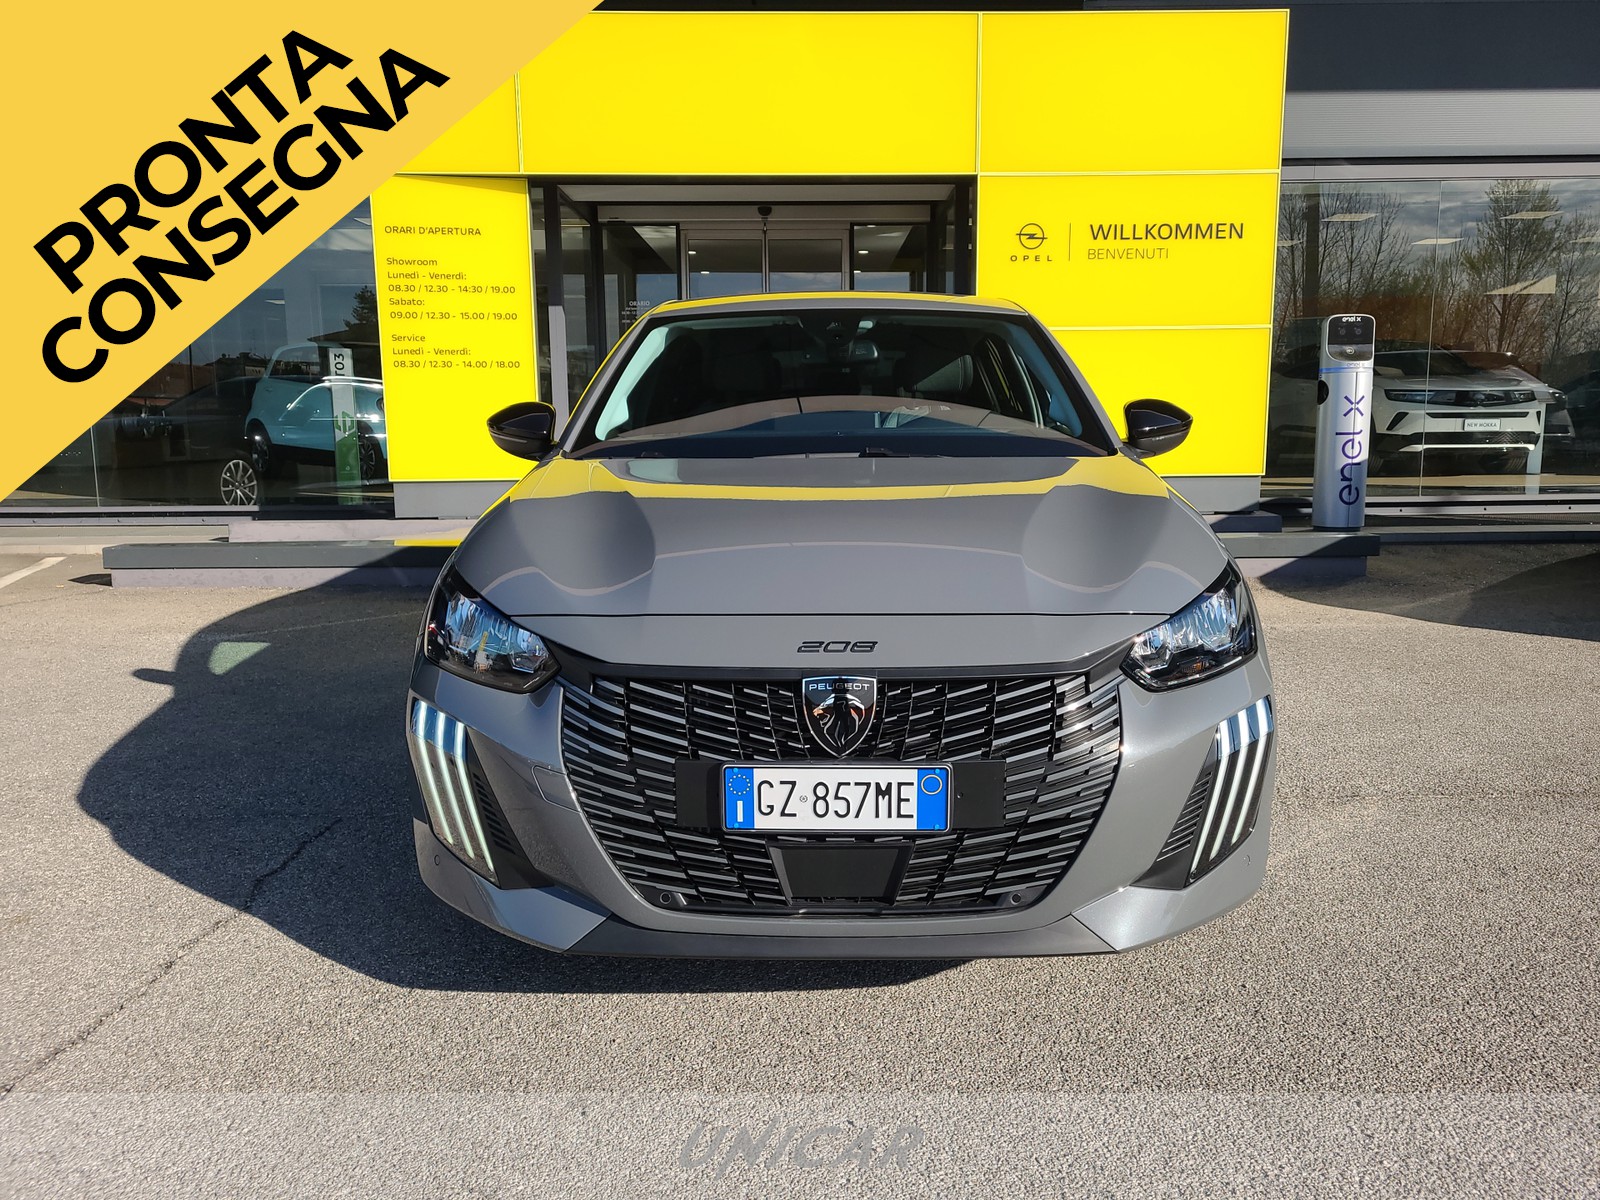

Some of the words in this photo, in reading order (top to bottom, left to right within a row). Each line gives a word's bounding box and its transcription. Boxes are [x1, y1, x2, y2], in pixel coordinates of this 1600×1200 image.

[384, 225, 416, 234] ORARI
[418, 226, 482, 236] D'APERTURA
[1089, 222, 1244, 241] WILLKOMMEN
[1010, 254, 1053, 262] OPEL
[1087, 247, 1169, 260] BENVENUTI
[386, 257, 438, 266] Showroom
[387, 271, 419, 279] Lunedì
[428, 272, 467, 280] Venerdì:
[388, 284, 416, 292] 08.30
[424, 284, 449, 292] 12.30
[491, 285, 516, 293] 19.00
[389, 297, 425, 306] Sabato:
[390, 311, 418, 320] 09.00
[426, 311, 451, 320] 12.30
[460, 312, 485, 321] 15.00
[493, 312, 518, 321] 19.00
[391, 333, 426, 342] Service
[392, 347, 424, 355] Lunedì
[433, 348, 471, 356] Venerdì:
[1342, 394, 1366, 418] x
[1336, 429, 1363, 506] enel
[797, 641, 879, 653] 208
[808, 682, 871, 691] PEUGEOT
